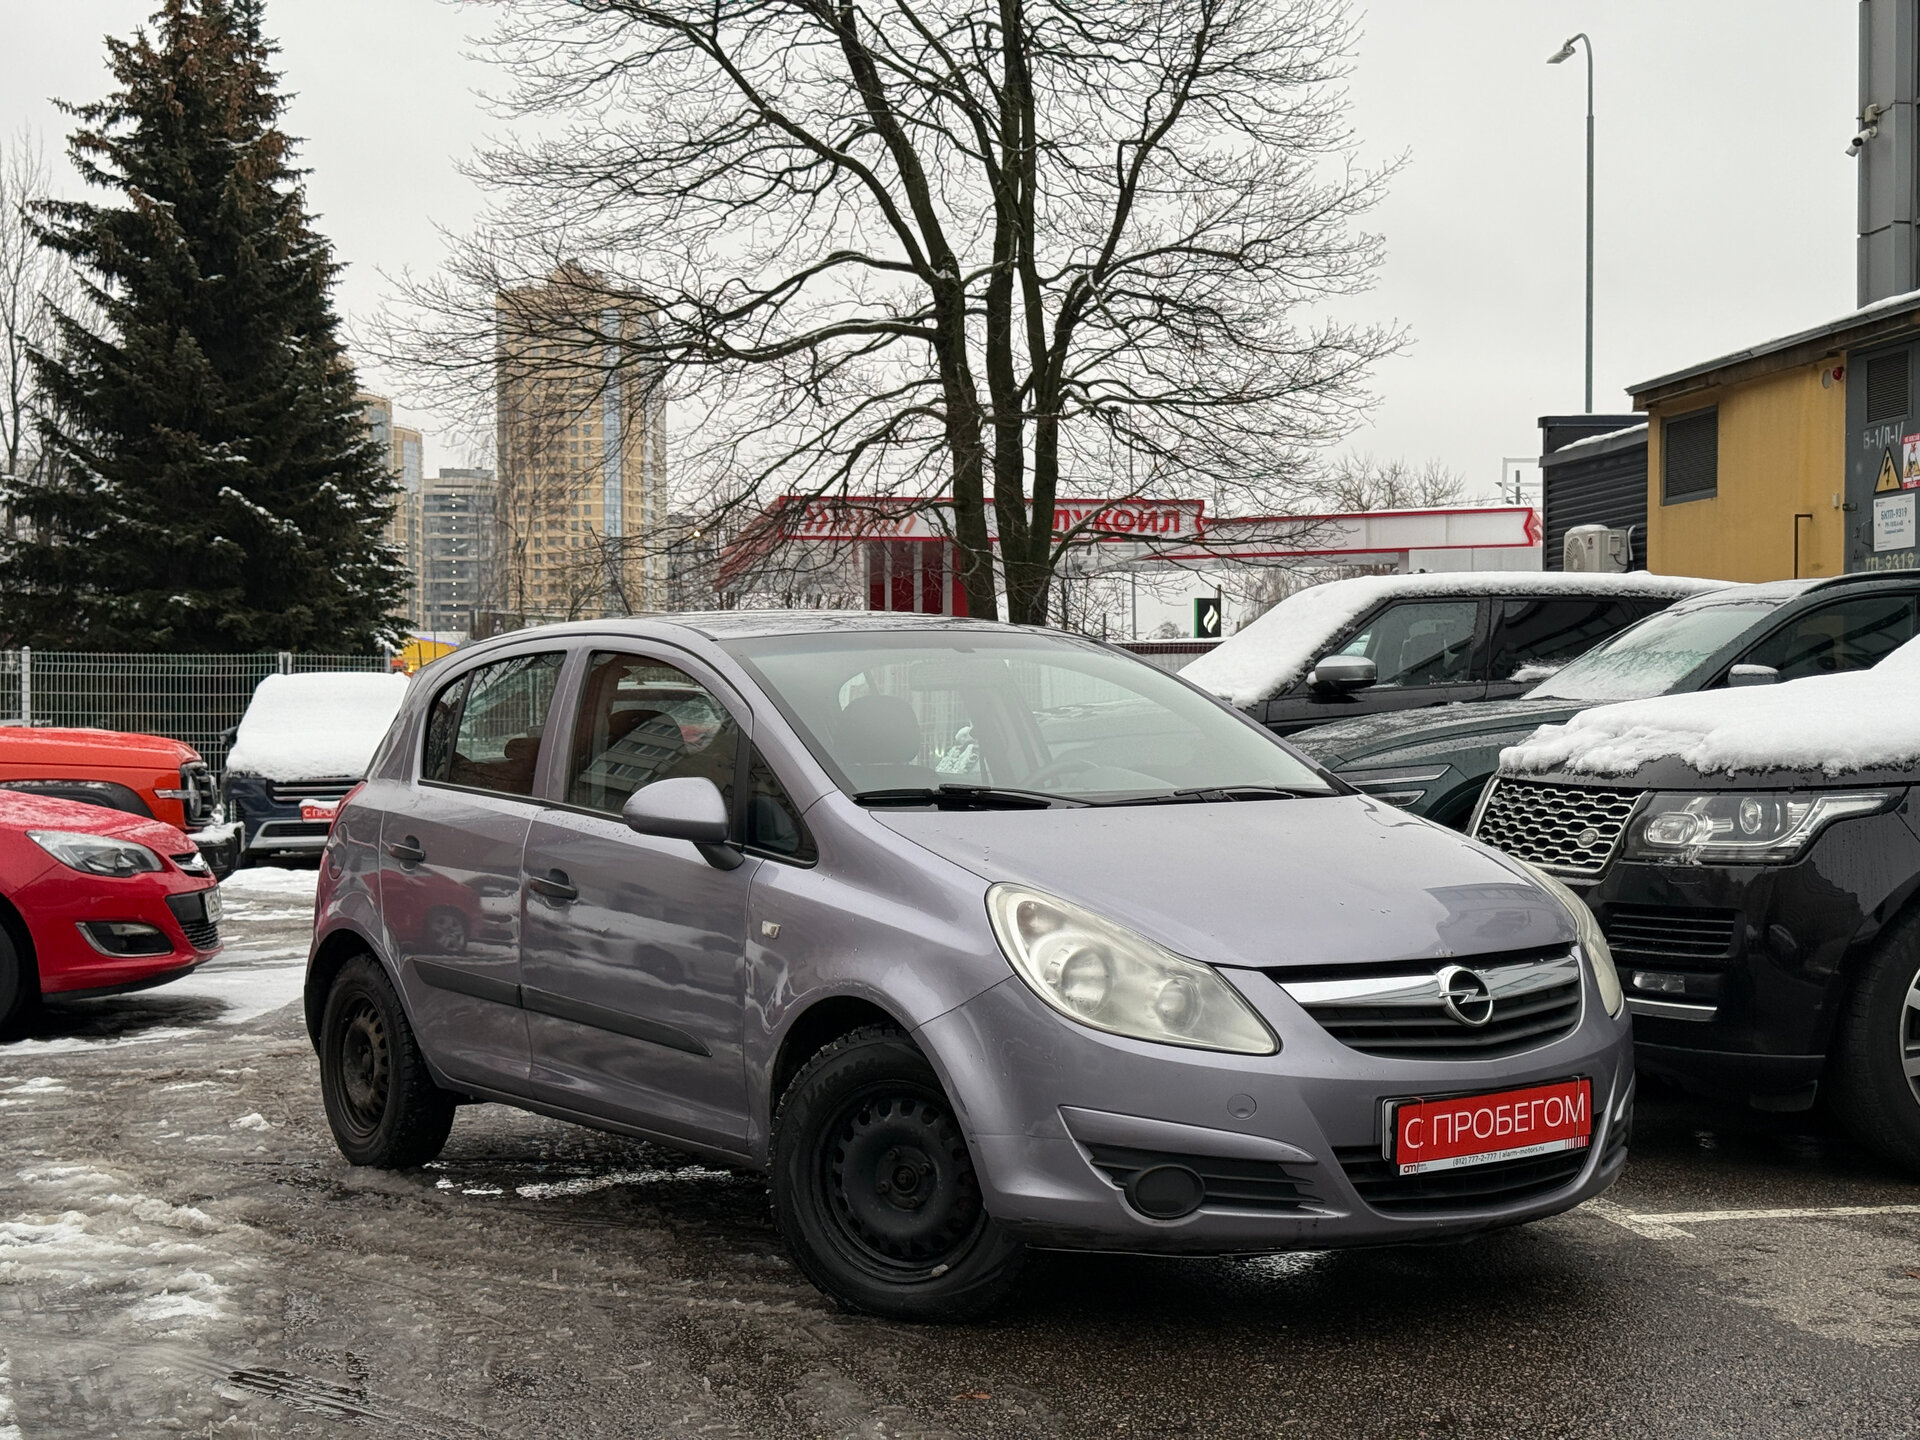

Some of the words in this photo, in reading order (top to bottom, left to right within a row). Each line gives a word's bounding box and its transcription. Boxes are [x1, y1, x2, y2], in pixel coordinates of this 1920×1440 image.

[1404, 1117, 1425, 1149] С
[1433, 1092, 1585, 1146] ПРОБЕГОМ
[1452, 1157, 1467, 1167] (812)
[1468, 1152, 1498, 1164] 777-2-777
[1502, 1145, 1545, 1158] alarm-motors.ru
